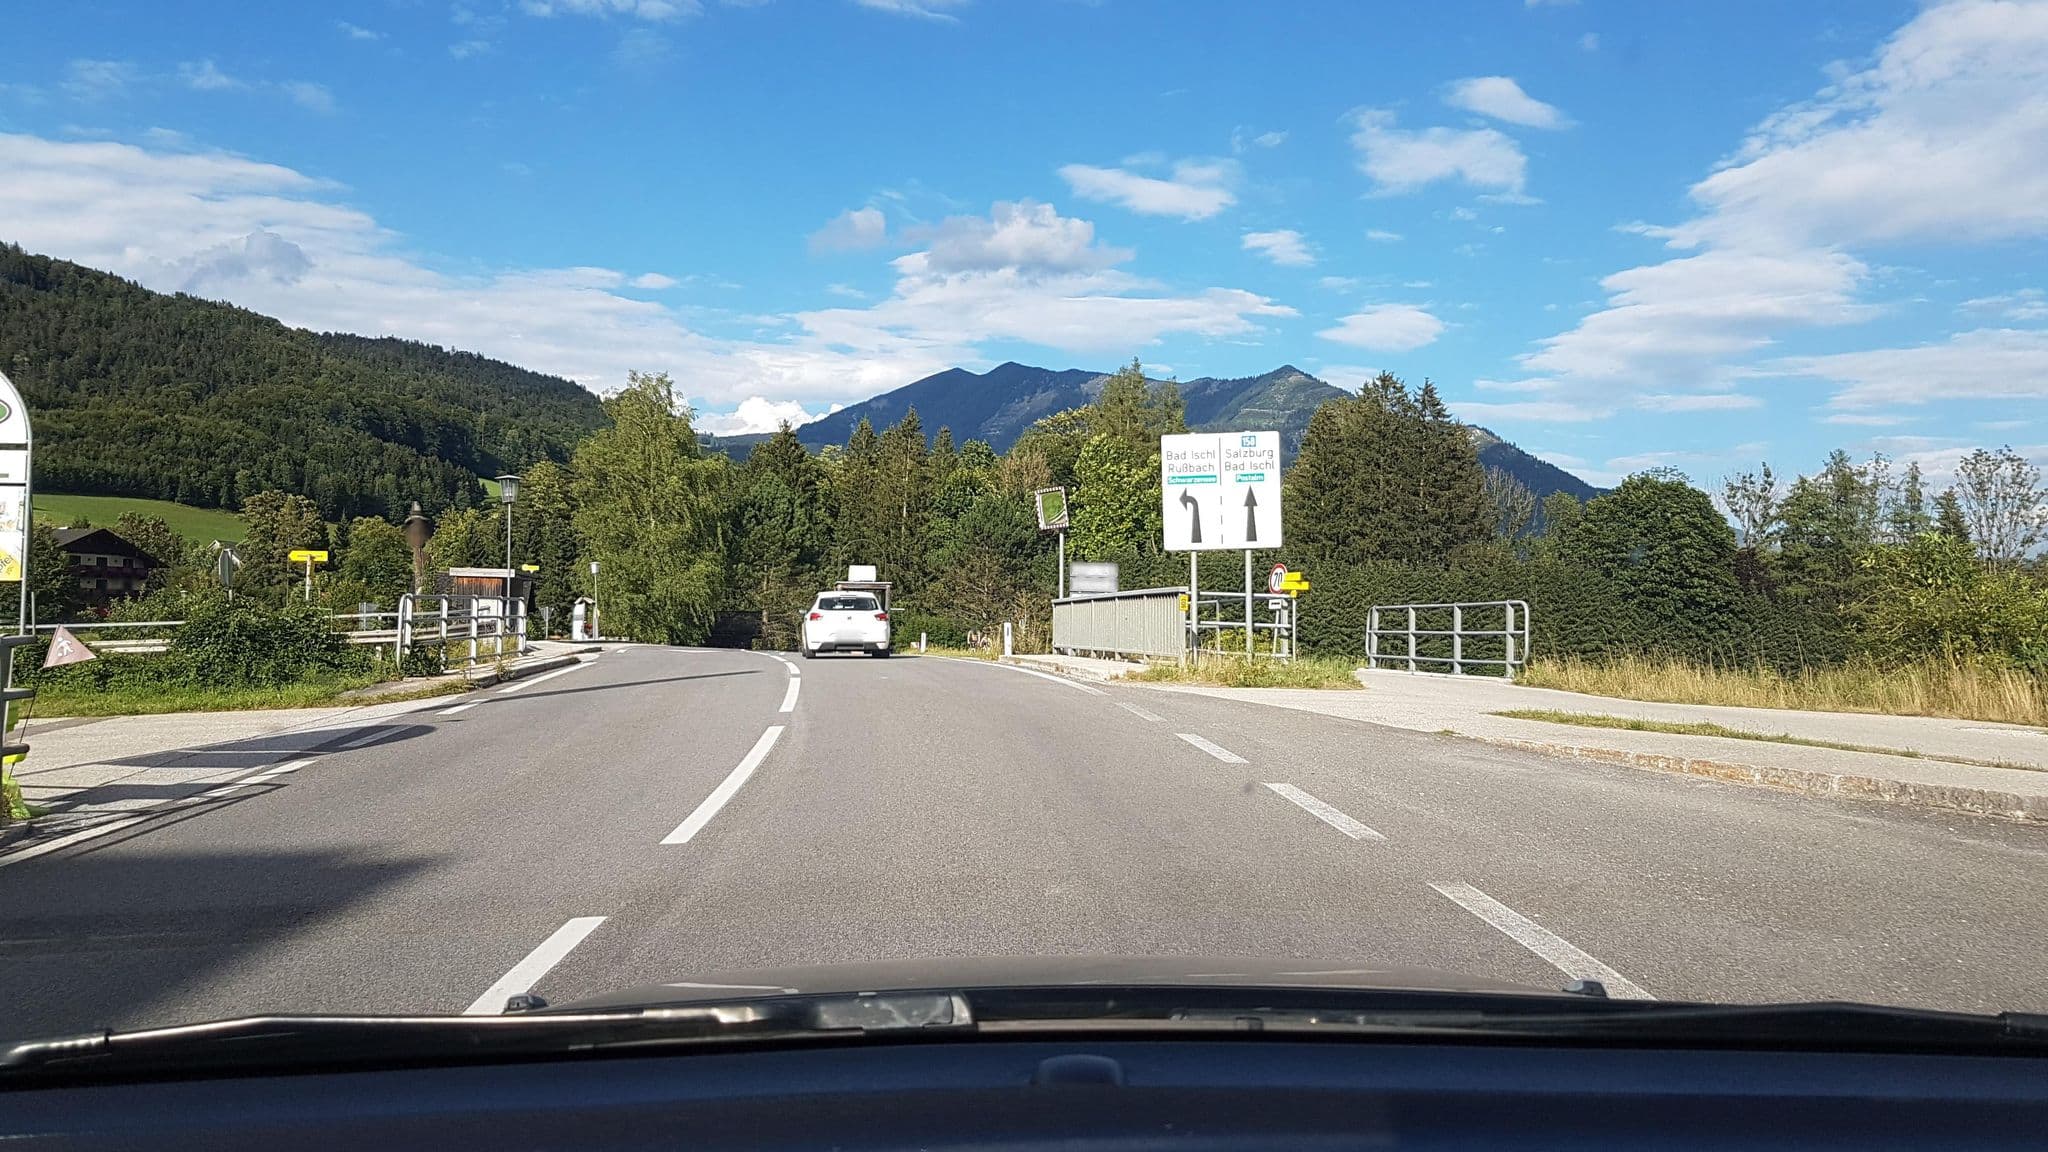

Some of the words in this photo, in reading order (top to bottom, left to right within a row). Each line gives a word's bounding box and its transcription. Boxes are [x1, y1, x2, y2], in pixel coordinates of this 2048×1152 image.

[1166, 450, 1187, 461] Bad
[1191, 450, 1216, 460] Ischl
[1225, 448, 1274, 460] Salzburg
[1168, 463, 1215, 473] Rußbach
[1224, 461, 1245, 471] Bad
[1249, 461, 1275, 470] Ischl
[1273, 572, 1283, 588] 70
